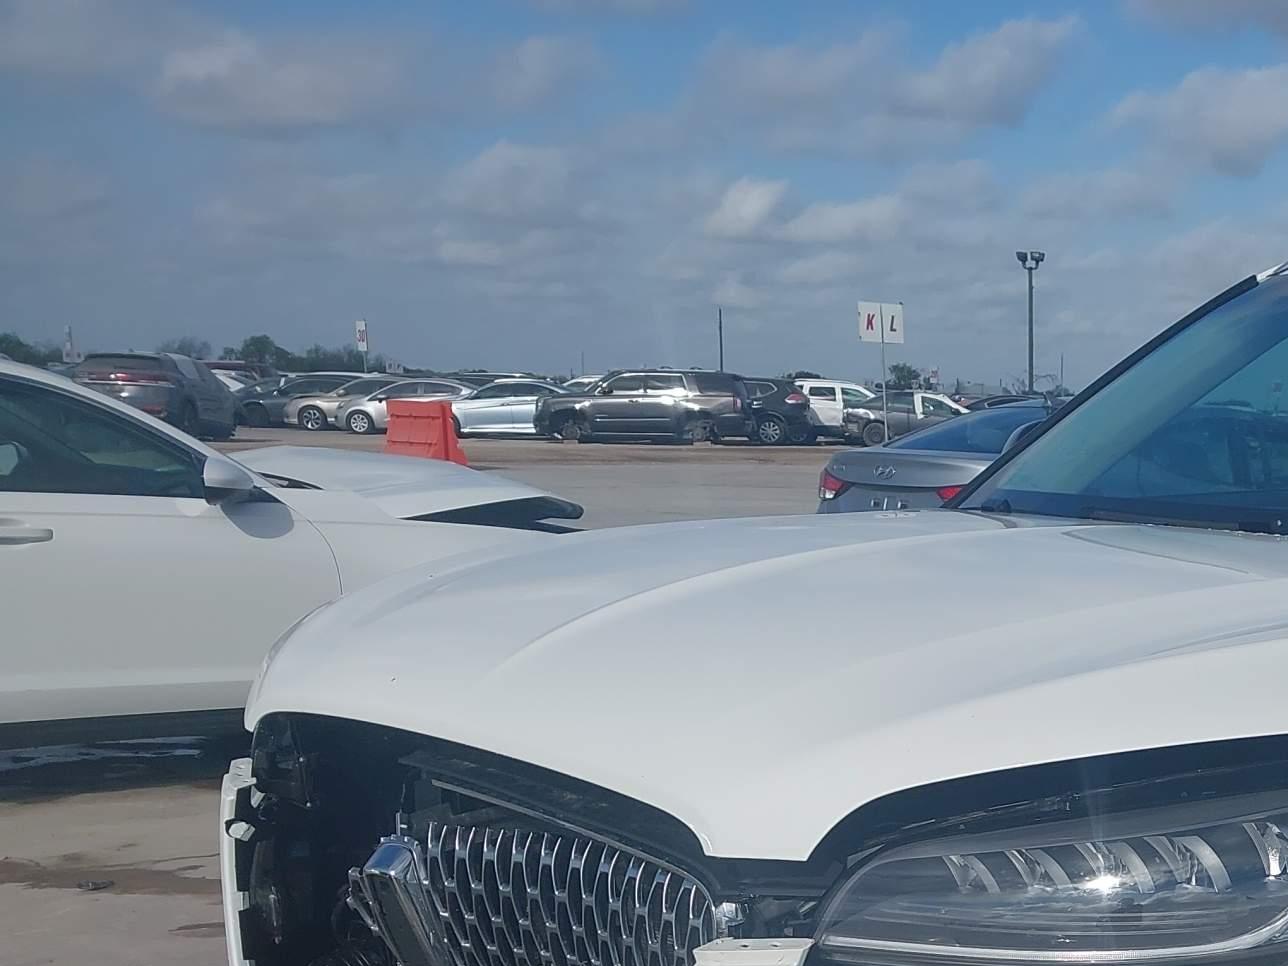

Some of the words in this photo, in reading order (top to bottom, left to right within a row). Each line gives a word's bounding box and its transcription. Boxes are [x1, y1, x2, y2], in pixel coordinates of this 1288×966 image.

[865, 313, 876, 331] K
[889, 315, 897, 332] L
[357, 329, 366, 342] 30
